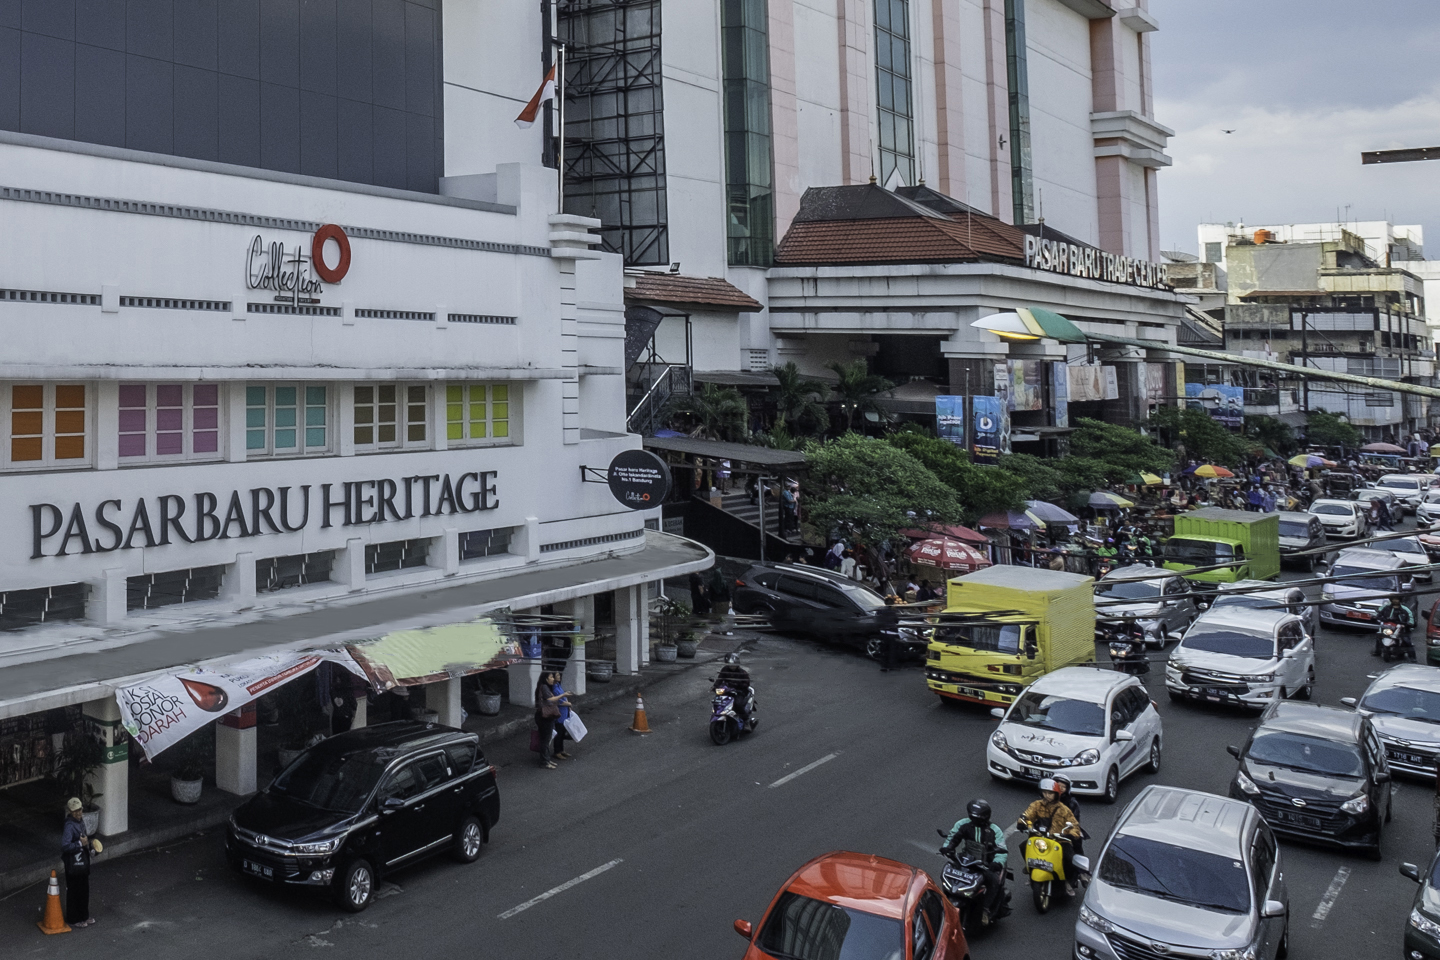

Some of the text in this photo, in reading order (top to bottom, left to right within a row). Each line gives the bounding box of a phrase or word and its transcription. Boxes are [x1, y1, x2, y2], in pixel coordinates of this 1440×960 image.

[248, 235, 323, 296] Collection
[1025, 234, 1068, 273] PASAR
[1070, 244, 1100, 278] BARU
[1101, 251, 1133, 283] TRADE
[321, 470, 499, 529] HERITAGE
[130, 690, 170, 718] OSIAL
[139, 707, 187, 744] DARAH
